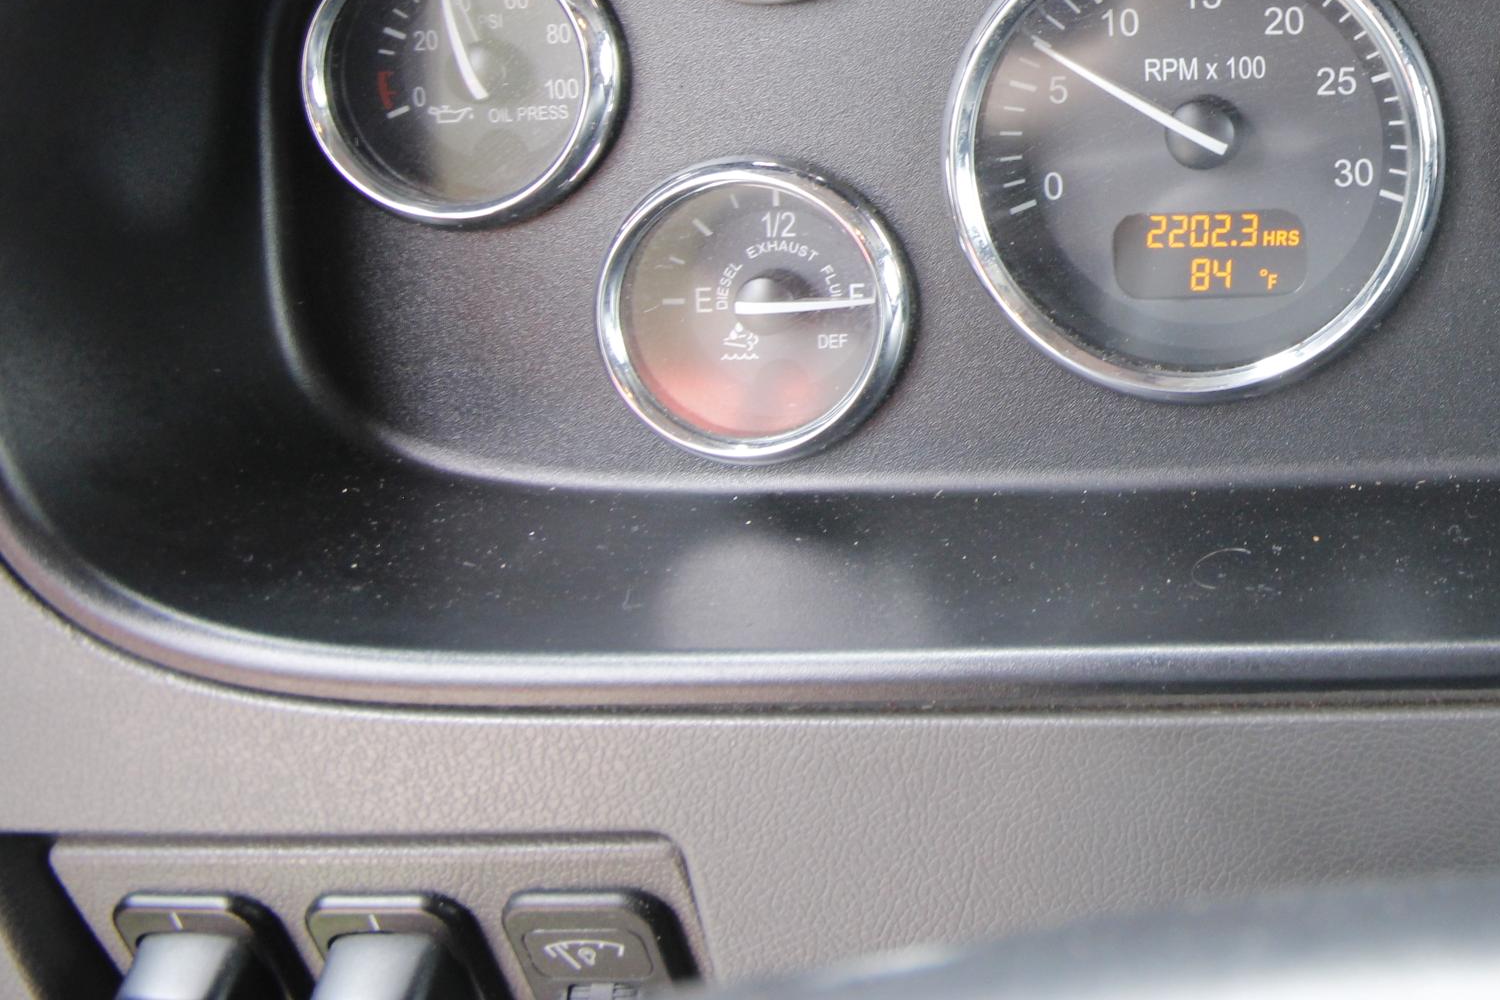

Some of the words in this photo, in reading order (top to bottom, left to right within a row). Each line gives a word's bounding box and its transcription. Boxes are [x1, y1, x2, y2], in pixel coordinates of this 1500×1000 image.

[477, 13, 503, 30] PSI
[547, 24, 571, 44] 80
[1101, 8, 1139, 37] 10
[1264, 6, 1304, 36] 20
[413, 31, 438, 51] 20
[1144, 58, 1199, 81] RPM
[1206, 63, 1219, 80] x
[1226, 55, 1266, 80] 100
[545, 79, 579, 100] 100
[1049, 75, 1068, 104] 5
[1317, 67, 1357, 96] 25
[414, 86, 426, 107] 0
[488, 108, 512, 122] OIL
[517, 105, 569, 121] PRESS
[1044, 172, 1064, 200] 0
[1334, 159, 1374, 188] 30
[762, 212, 796, 237] 1/2
[1146, 213, 1258, 249] 2202.3
[1263, 229, 1300, 247] HRS
[716, 262, 744, 310] DIESEL
[746, 240, 819, 261] EXHAUST
[819, 264, 843, 298] FLUI
[1190, 257, 1232, 292] 84
[696, 287, 713, 313] E
[818, 333, 849, 349] DEF
